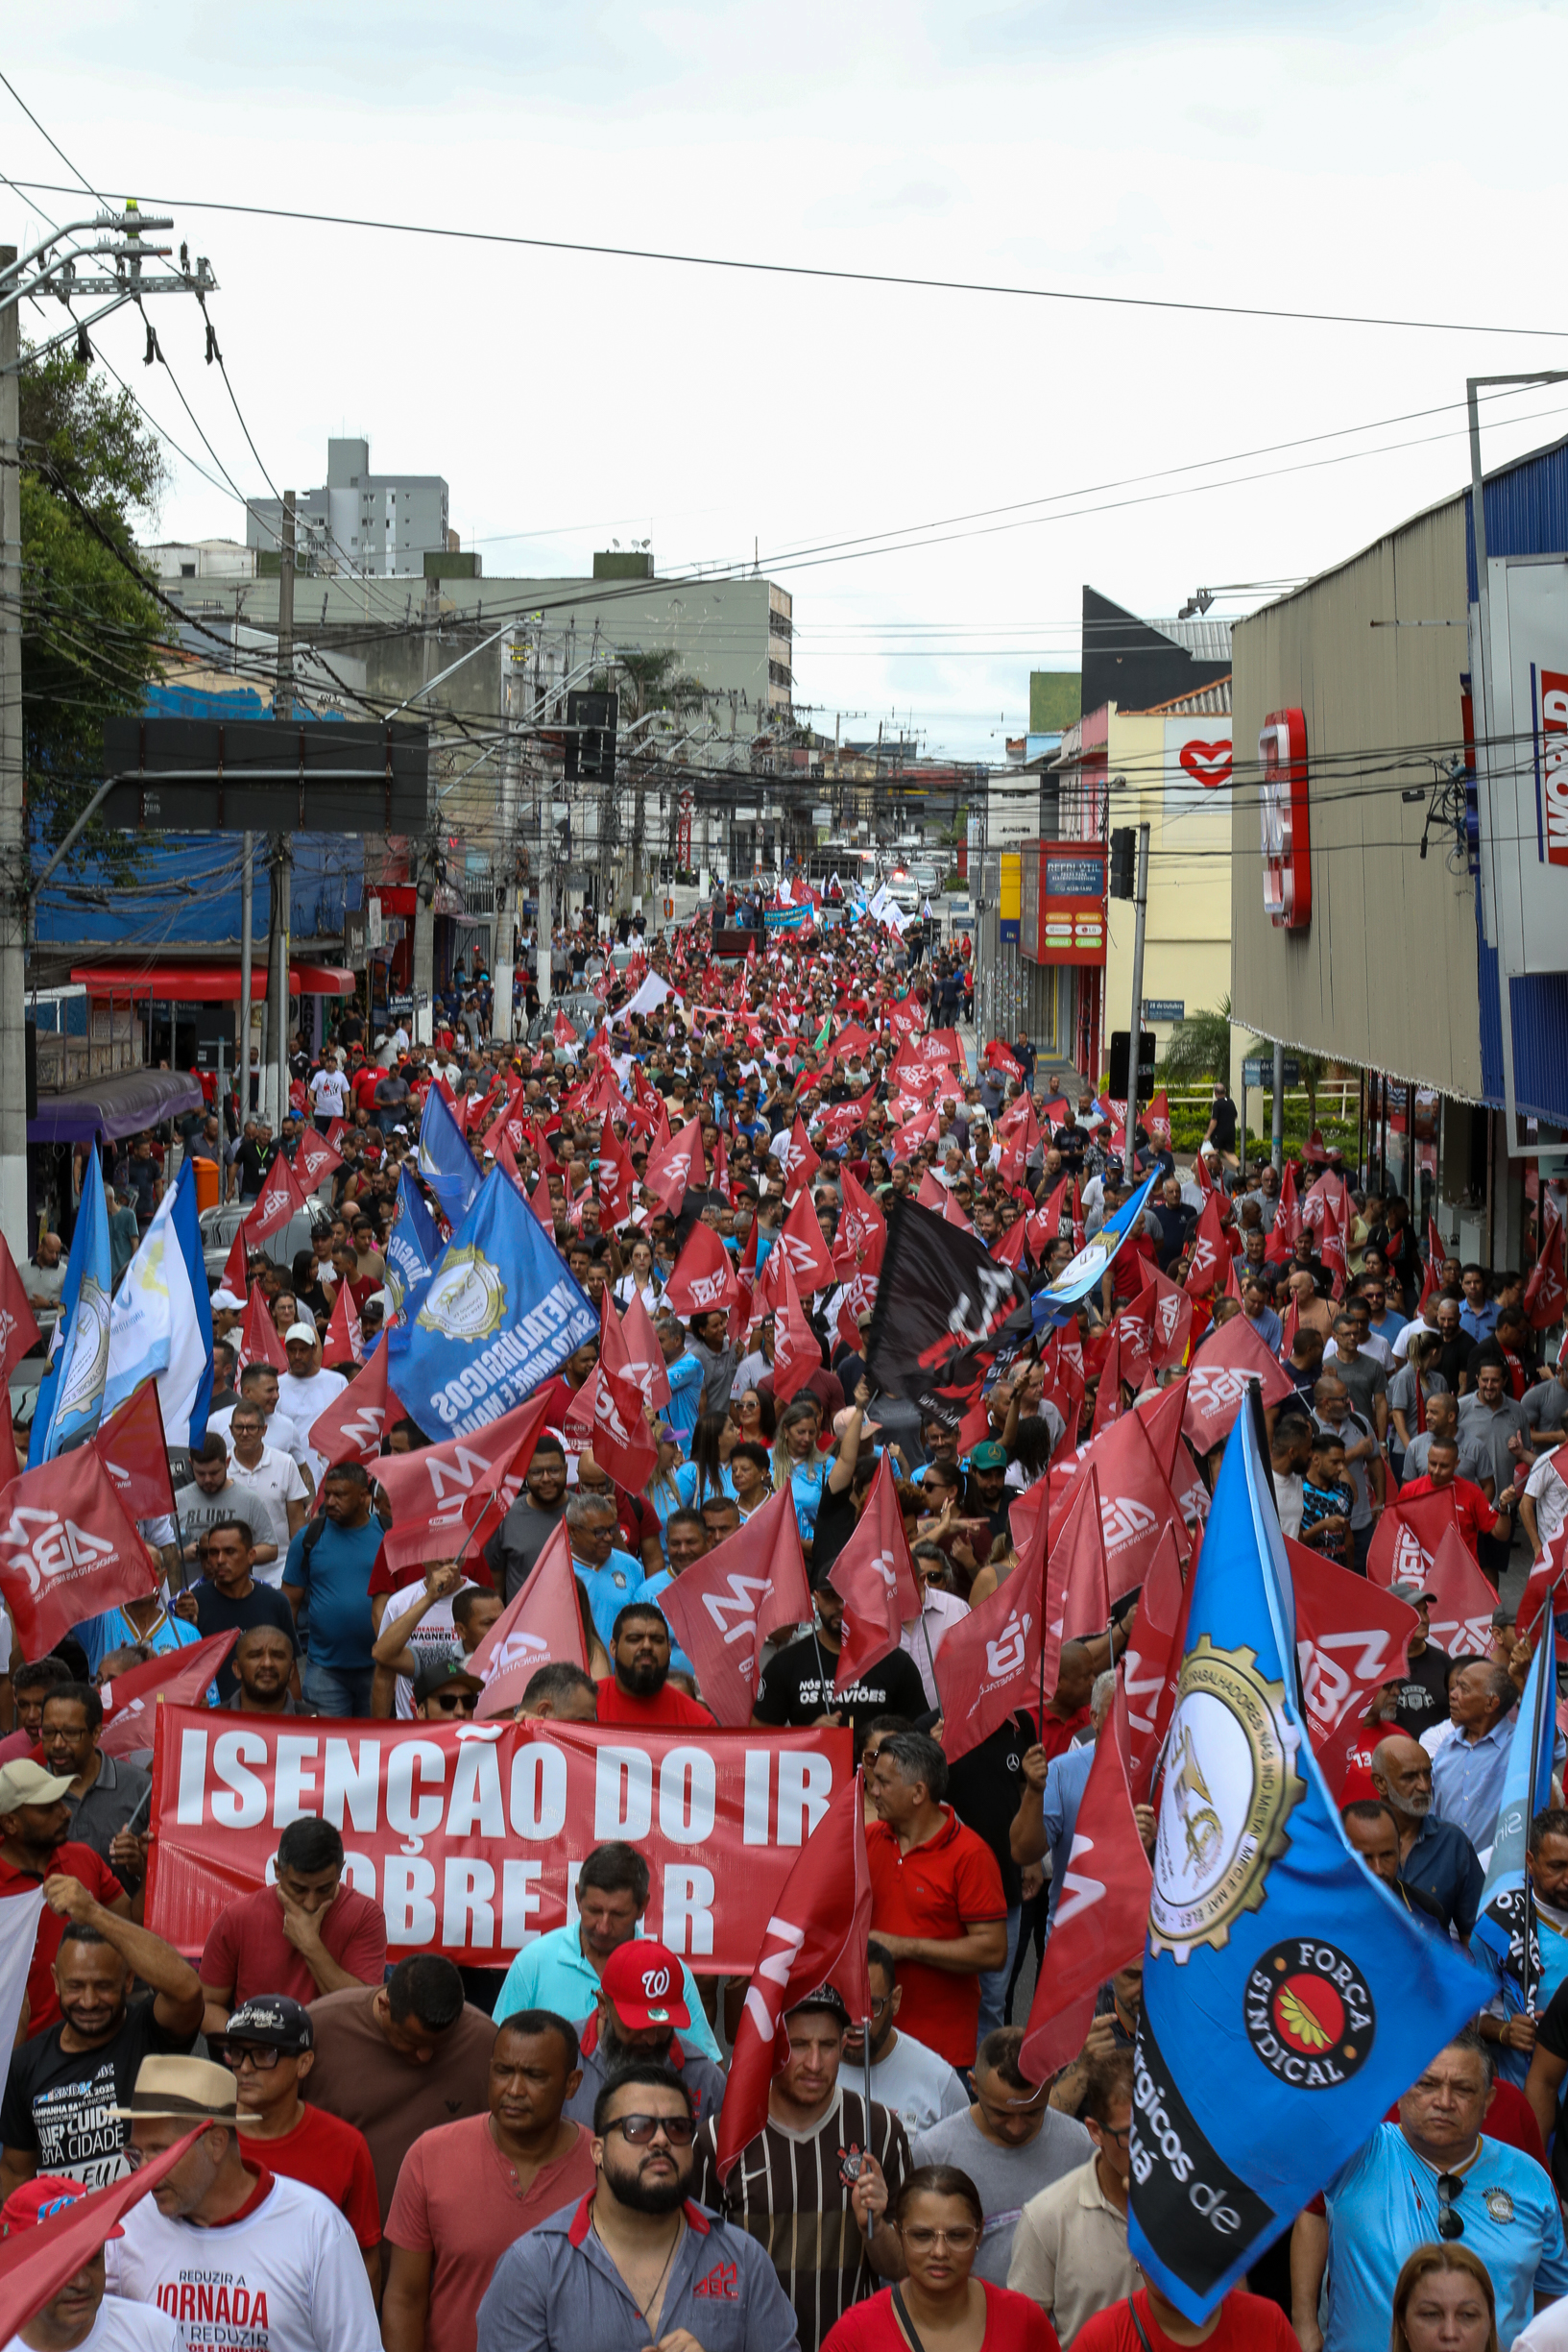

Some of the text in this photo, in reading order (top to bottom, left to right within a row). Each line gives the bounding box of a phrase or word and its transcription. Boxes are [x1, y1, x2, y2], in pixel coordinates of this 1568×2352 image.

[186, 1508, 236, 1523] BLUNT
[799, 1678, 821, 1691] NÓS
[799, 1690, 819, 1705] OS
[177, 1724, 832, 1855] ISENÇÃO DO IR
[1298, 1942, 1373, 2033] FORÇA
[1247, 1969, 1345, 2087] SINDICAL
[66, 2101, 122, 2137] CUIDA
[68, 2123, 125, 2161] CIDADE
[1189, 2181, 1242, 2236] de
[179, 2269, 247, 2288] REDUZIR A
[191, 2325, 269, 2348] REDUZIR
